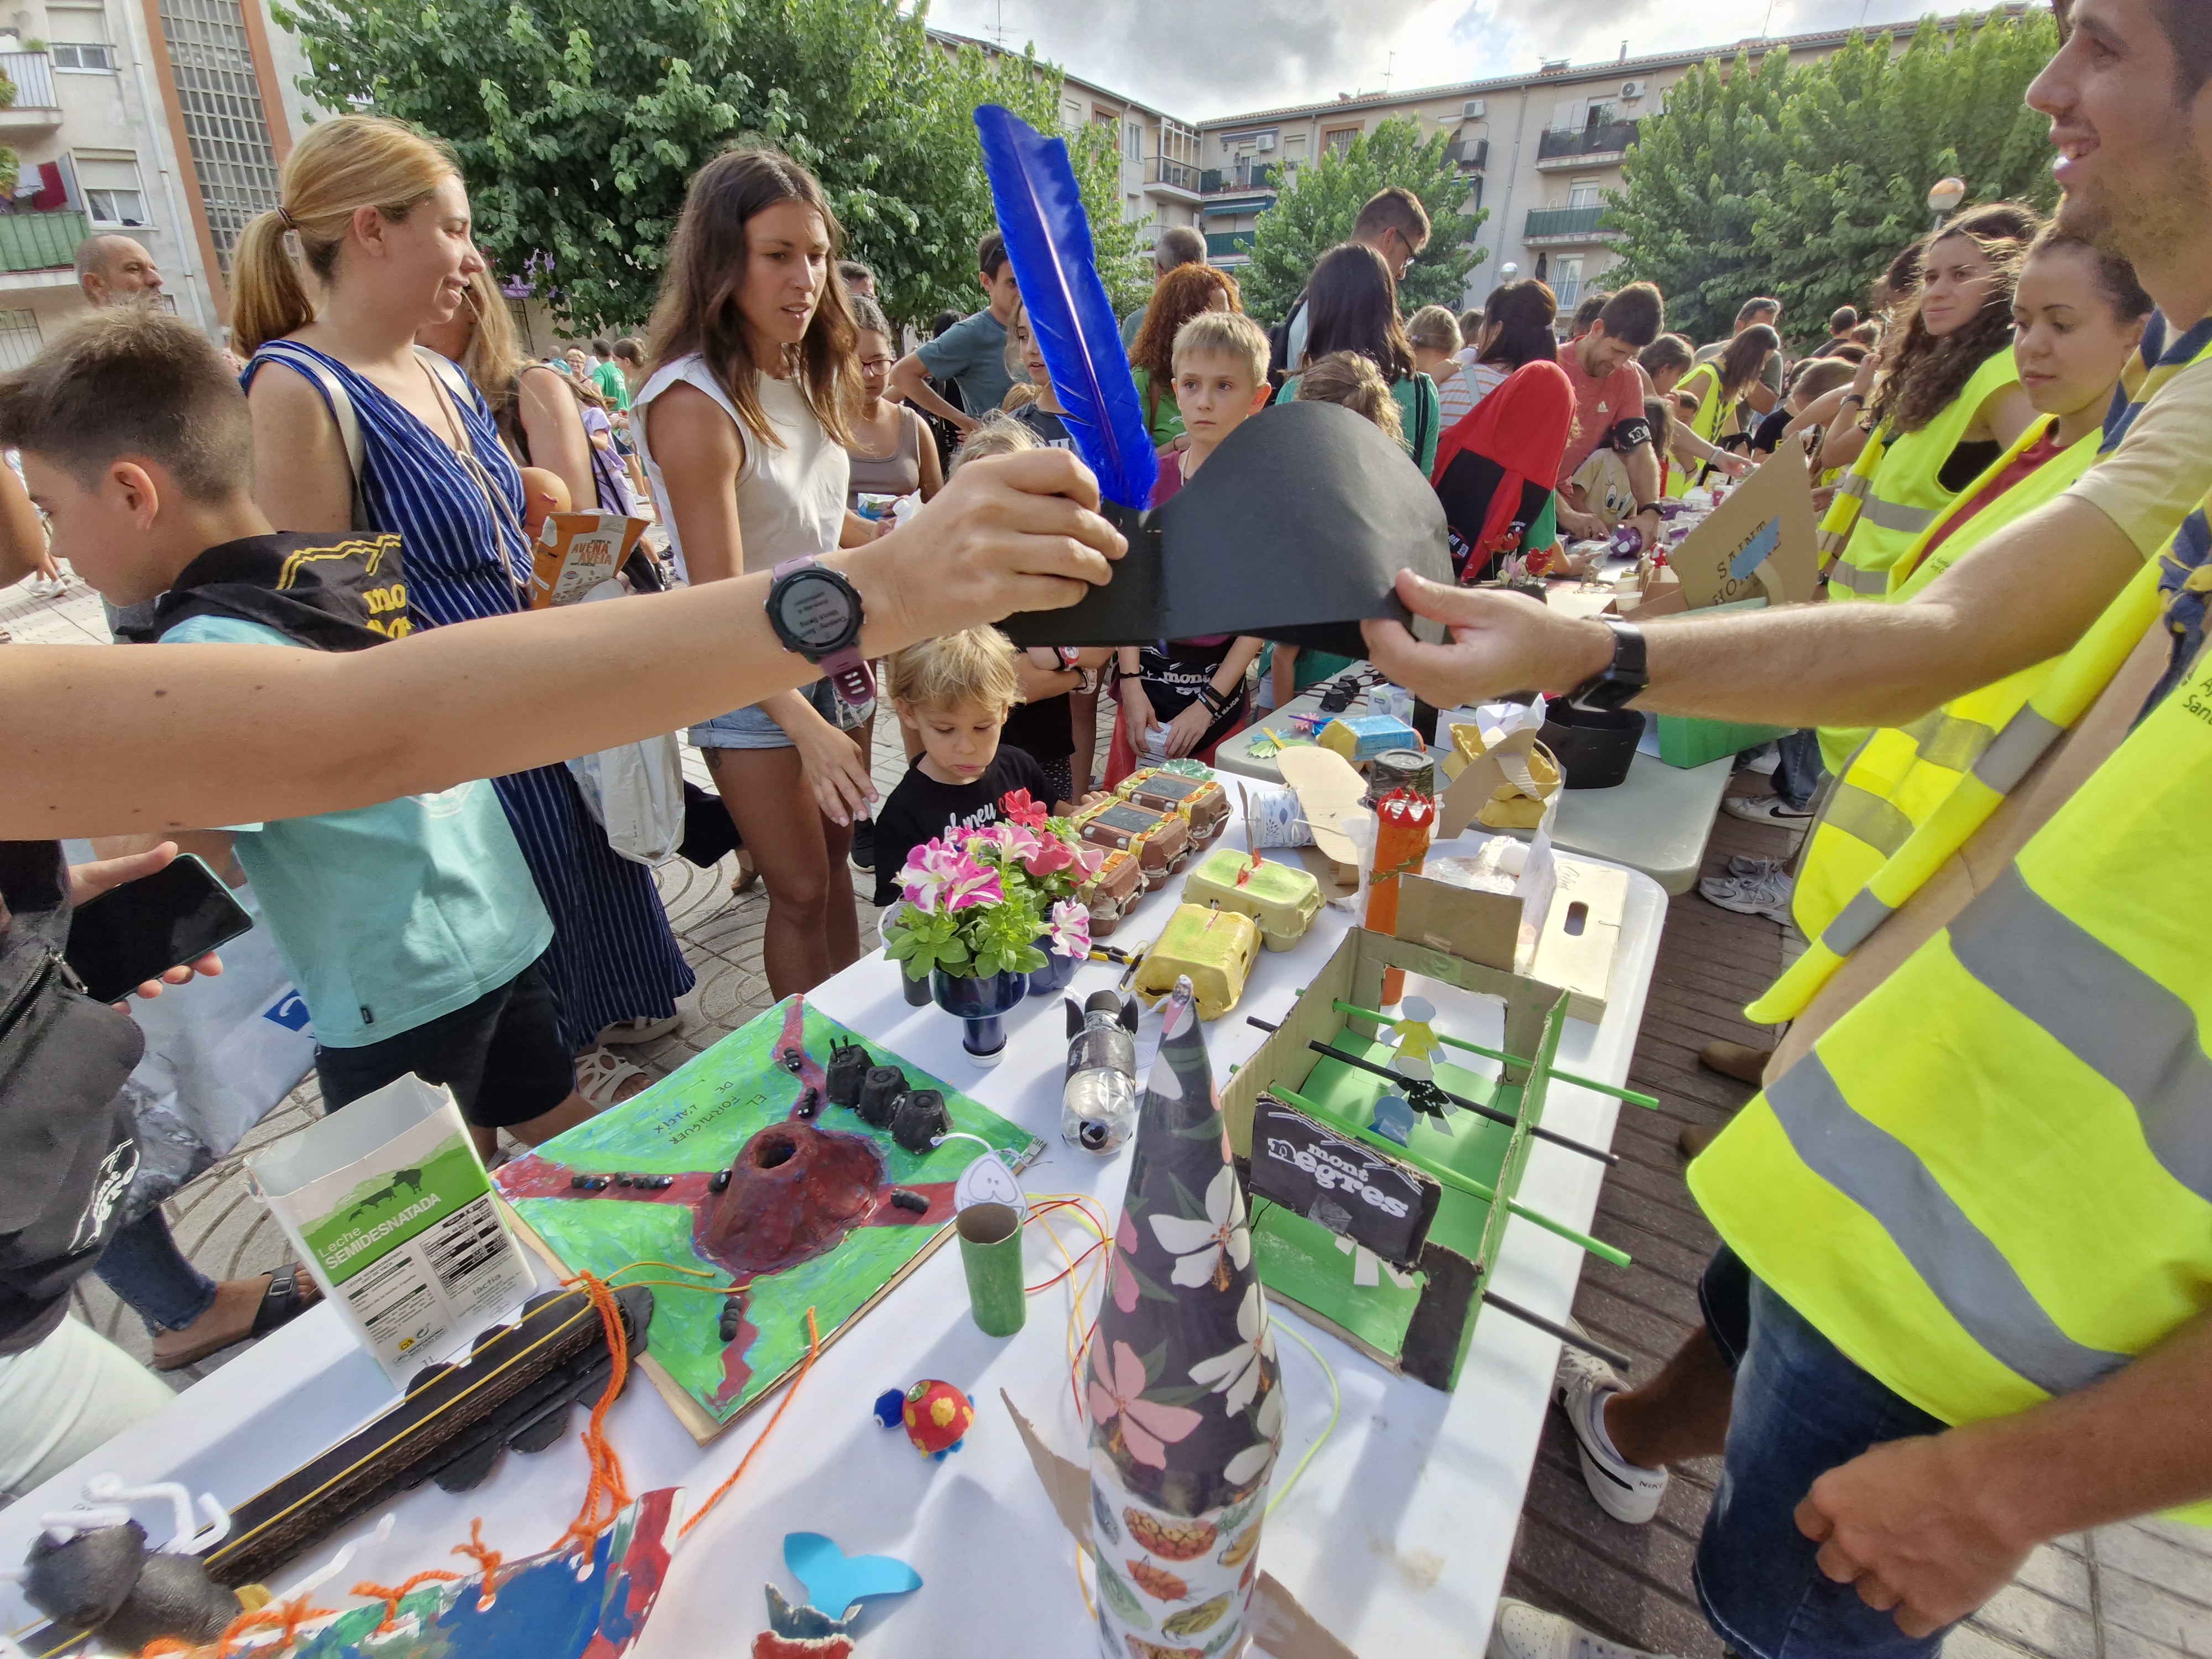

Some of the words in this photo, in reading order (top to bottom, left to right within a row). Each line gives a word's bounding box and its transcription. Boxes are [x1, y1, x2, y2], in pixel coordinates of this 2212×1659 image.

[571, 543, 609, 554] AVENA
[962, 803, 997, 829] meu
[714, 1081, 733, 1094] DE
[746, 1094, 767, 1105] EL
[1308, 1142, 1369, 1183] mont
[1267, 1137, 1409, 1219] negres
[317, 1227, 362, 1258] Leche
[325, 1193, 441, 1270] SEMIDESNATADA
